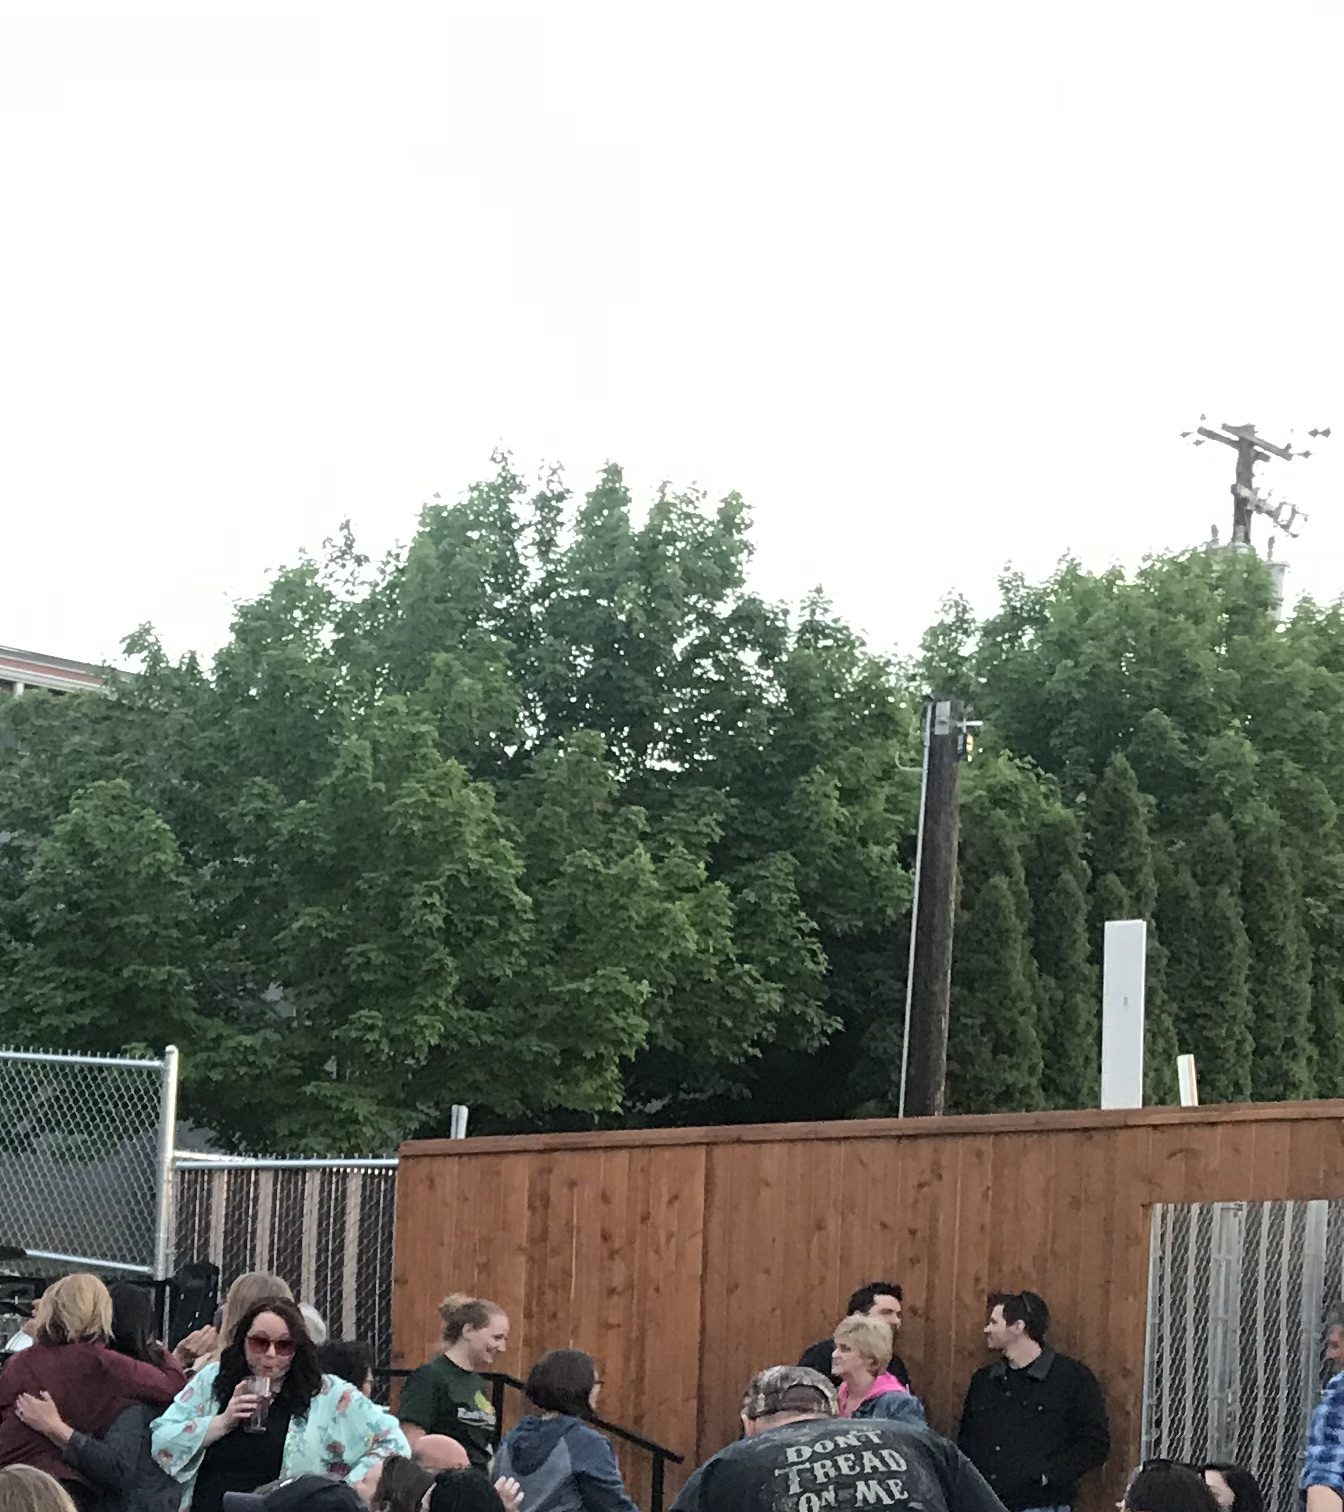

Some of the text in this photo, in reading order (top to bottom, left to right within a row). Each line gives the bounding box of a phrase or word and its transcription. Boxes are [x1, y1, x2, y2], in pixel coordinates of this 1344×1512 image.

[786, 1430, 883, 1463] DON'T
[774, 1449, 908, 1495] TREAD
[855, 1479, 909, 1507] ME
